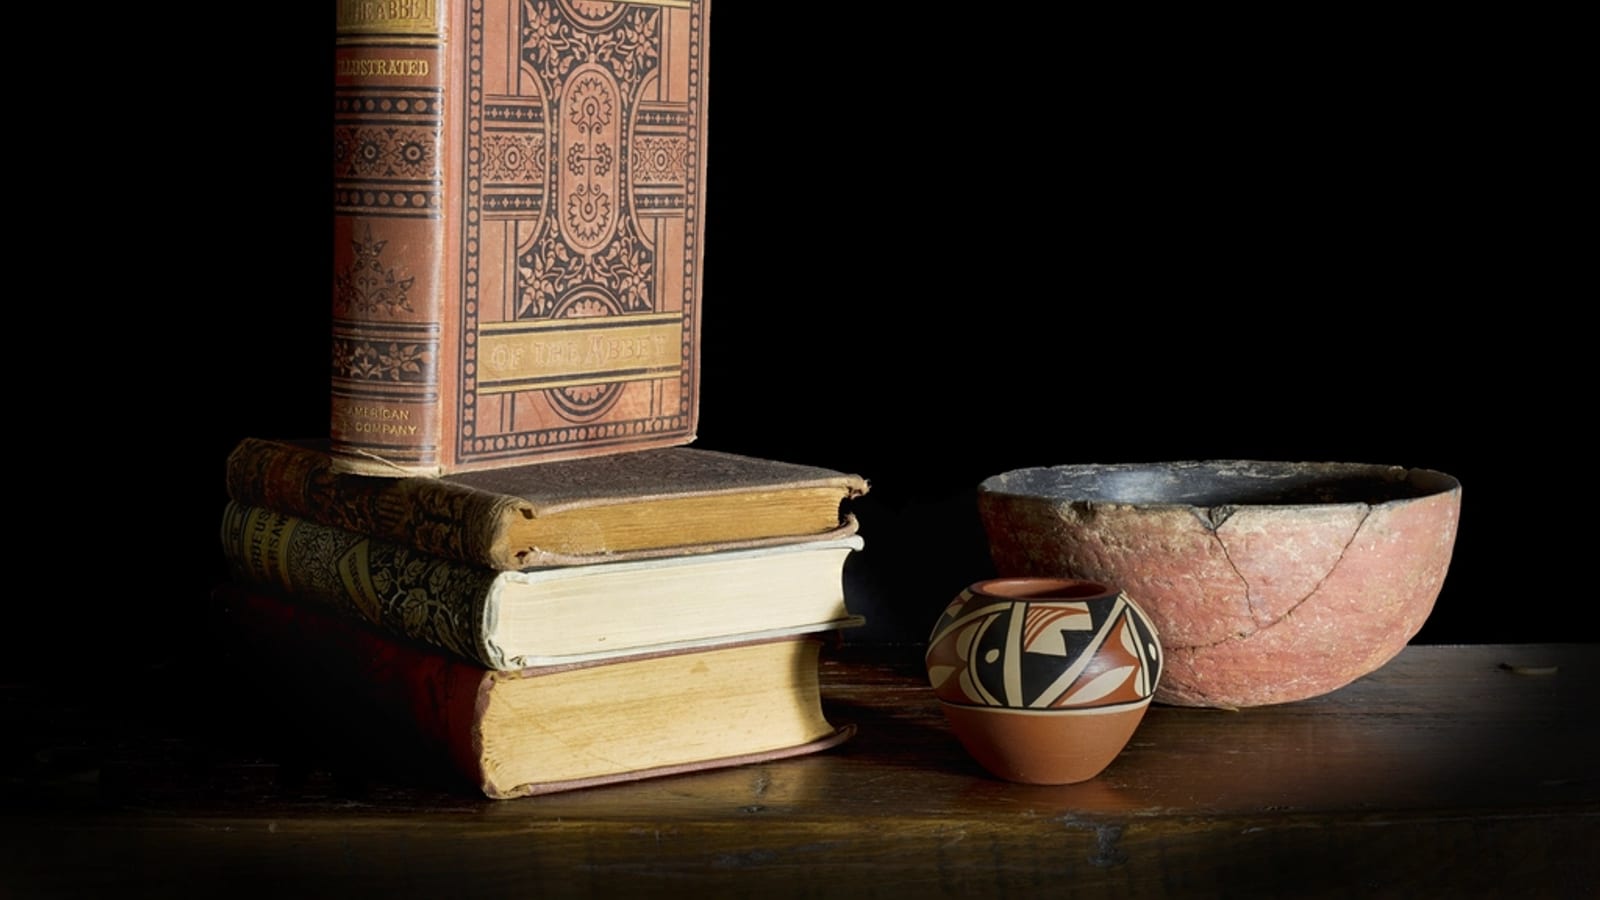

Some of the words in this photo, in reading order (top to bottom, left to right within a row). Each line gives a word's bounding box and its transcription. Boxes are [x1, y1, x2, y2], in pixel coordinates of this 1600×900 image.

[491, 343, 526, 370] OF
[534, 341, 579, 368] THE
[346, 406, 409, 420] AMERICAN
[354, 421, 417, 435] COMPANY
